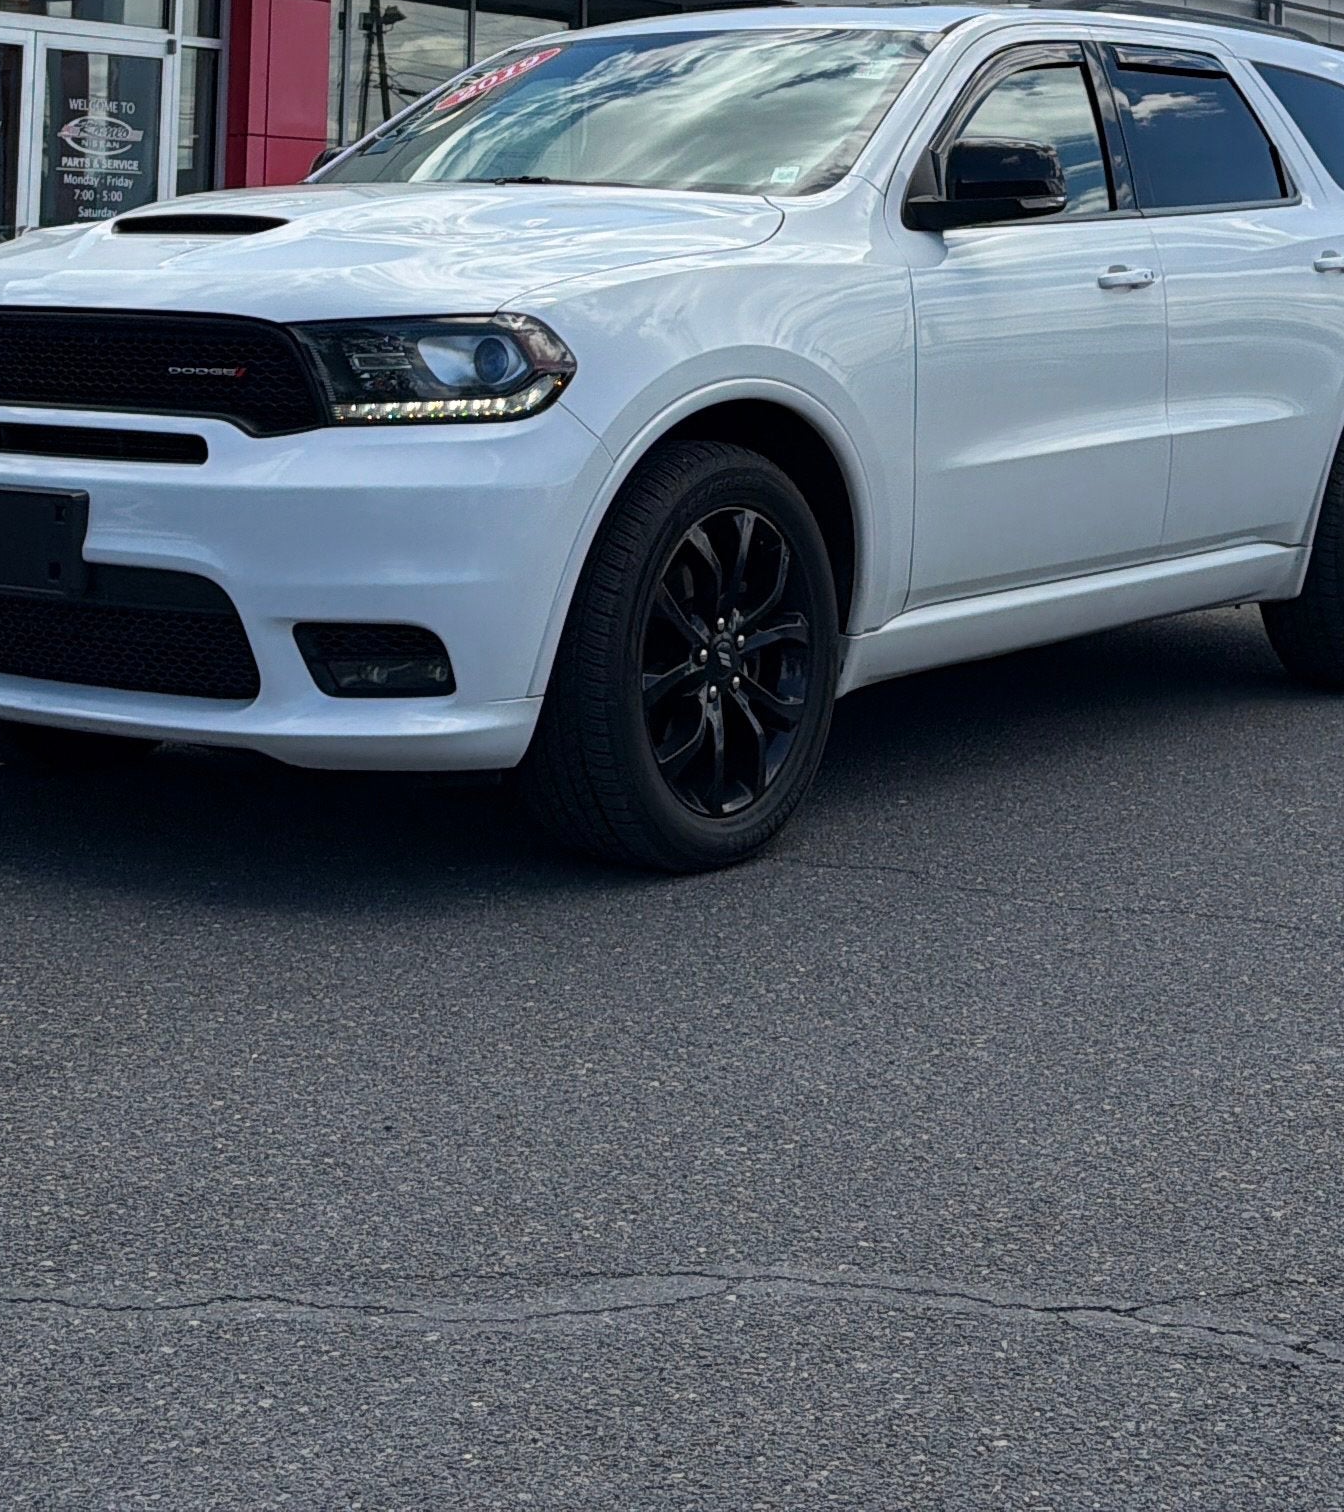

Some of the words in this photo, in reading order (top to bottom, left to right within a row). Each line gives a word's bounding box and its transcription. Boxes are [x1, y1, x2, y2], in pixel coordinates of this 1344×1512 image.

[457, 54, 540, 102] 2019
[68, 97, 118, 114] WELCOME
[120, 101, 136, 114] TO
[80, 139, 120, 149] NISSAN
[61, 156, 91, 168] PARTS
[92, 158, 99, 168] &
[103, 158, 139, 170] SERVICE
[63, 173, 99, 188] Monday
[106, 175, 133, 189] Friday
[73, 188, 95, 201] 7:00
[102, 190, 123, 202] 5:00
[77, 205, 118, 218] Saturday
[168, 366, 236, 377] DODGE
